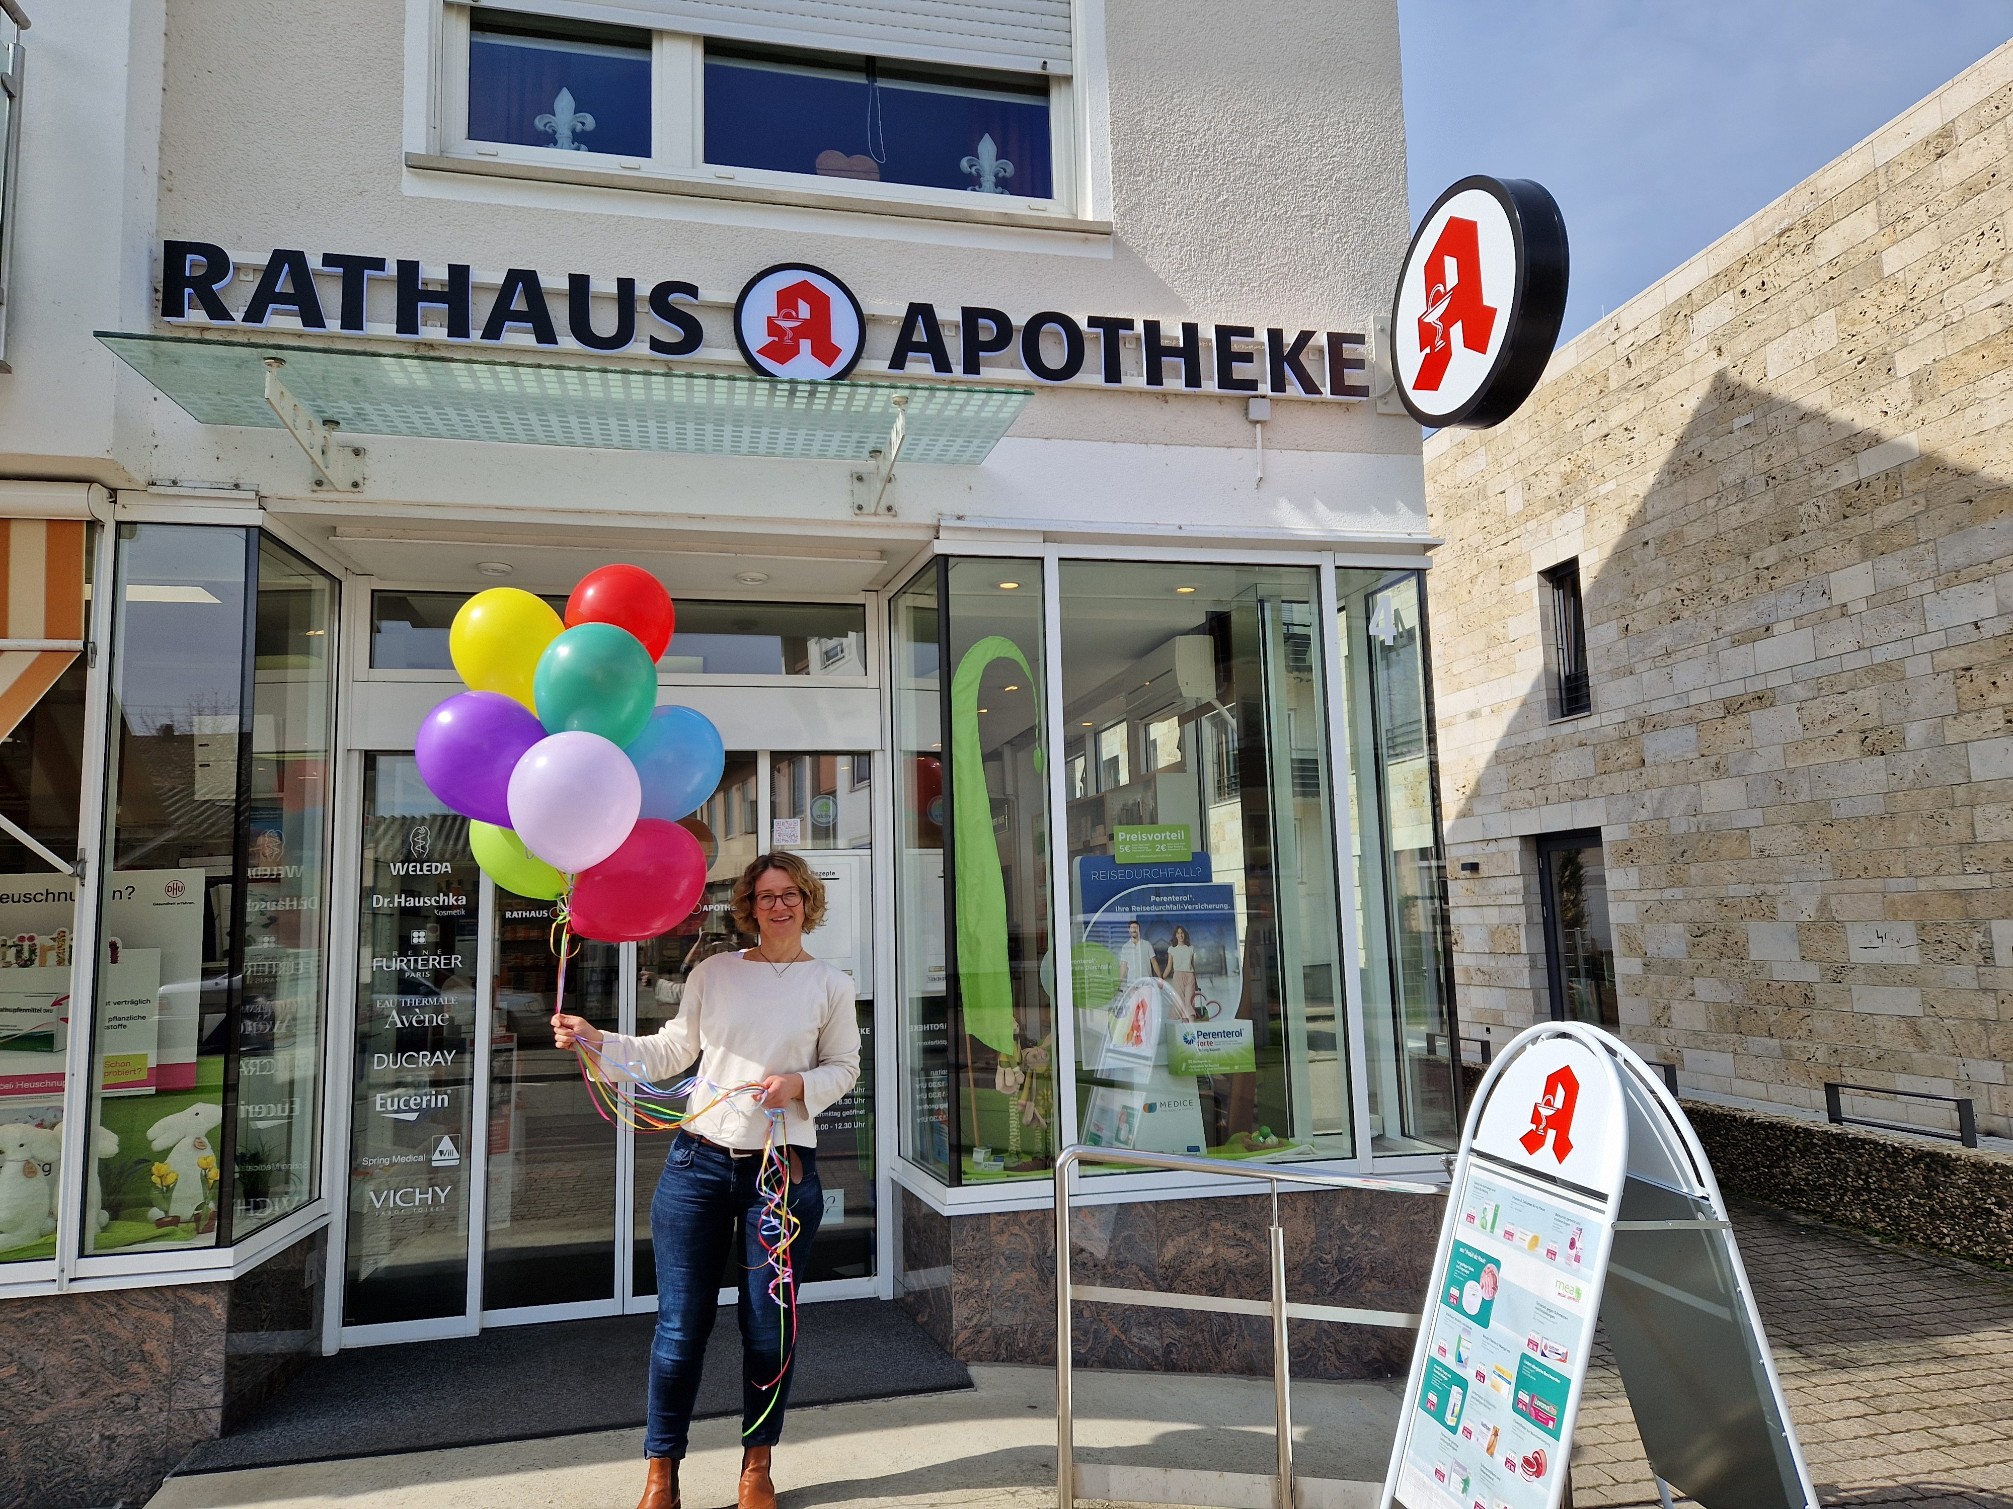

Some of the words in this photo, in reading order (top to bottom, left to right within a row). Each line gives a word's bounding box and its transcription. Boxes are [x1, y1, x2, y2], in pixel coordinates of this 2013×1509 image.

[161, 239, 704, 356] RATHAUS
[887, 302, 1369, 398] APOTHEKE
[1369, 595, 1397, 645] 4
[1119, 830, 1185, 841] Preisvorteil
[1120, 844, 1131, 853] 5€
[1156, 844, 1167, 852] 2€
[390, 862, 452, 875] WELEDA
[1091, 867, 1202, 881] REISEDURCHFALL?
[167, 883, 184, 896] DHU
[372, 893, 467, 908] Dr.Hauschka
[434, 908, 466, 917] Kosmetik
[1131, 902, 1231, 912] Reisedurchfall-Versicherung.
[505, 909, 548, 919] RATHAUS
[372, 955, 463, 972] FURTERER
[112, 999, 151, 1007] verträglich
[376, 999, 397, 1008] EAU
[400, 996, 458, 1007] THERMALE
[108, 1014, 147, 1024] pflanzliche
[384, 1009, 450, 1029] Avène
[1196, 1028, 1243, 1040] Perenterol
[104, 1060, 131, 1069] Schon
[373, 1050, 457, 1070] DUCRAY
[104, 1067, 142, 1079] probiert?
[853, 1086, 866, 1094] Uhr
[1160, 1100, 1194, 1109] MEDICE
[835, 1122, 852, 1130] 12.30
[853, 1121, 866, 1129] Uhr
[362, 1157, 390, 1166] Spring
[392, 1154, 426, 1164] Medical
[369, 1185, 452, 1209] VICHY
